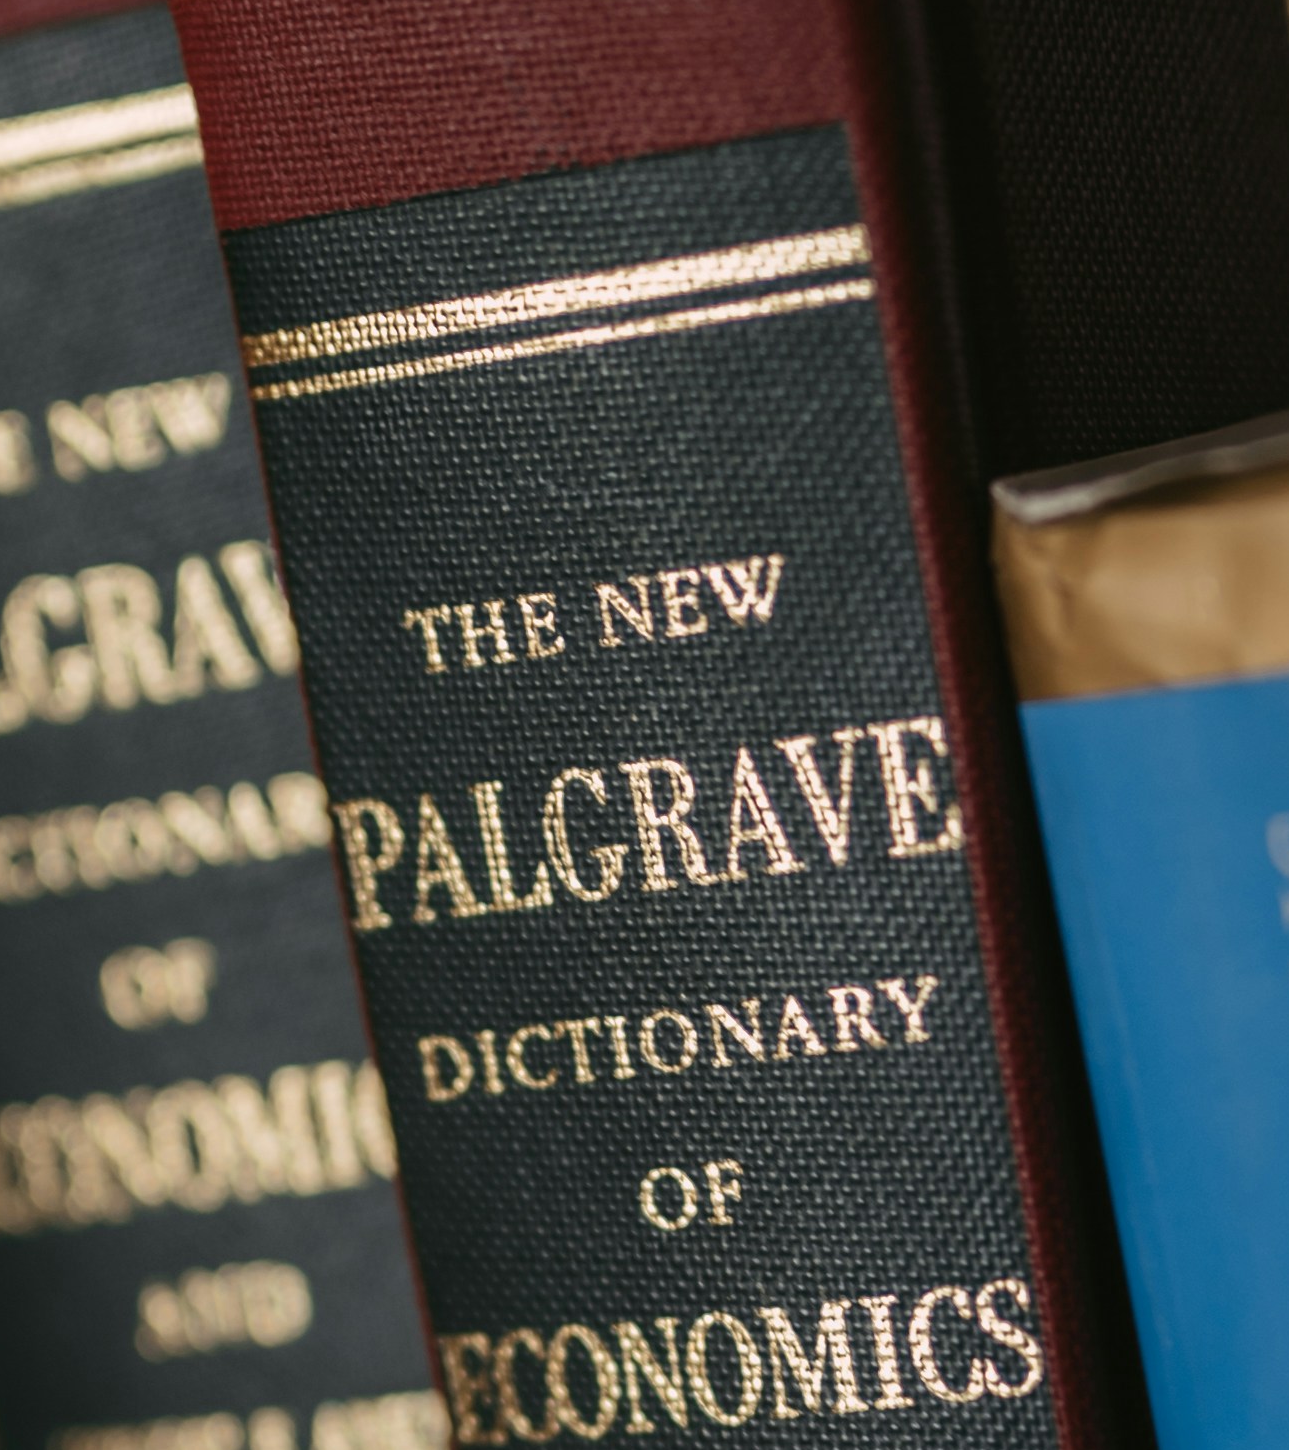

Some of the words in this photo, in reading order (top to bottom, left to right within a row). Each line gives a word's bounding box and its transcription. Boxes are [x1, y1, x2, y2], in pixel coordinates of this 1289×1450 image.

[46, 372, 233, 482] NEW
[404, 592, 567, 673] THE
[597, 553, 786, 651] NEW
[331, 714, 965, 934] PALGRAVE
[418, 974, 940, 1103] DICTIONARY
[639, 1158, 745, 1231] OF
[437, 1278, 1046, 1446] ECONOMICS
